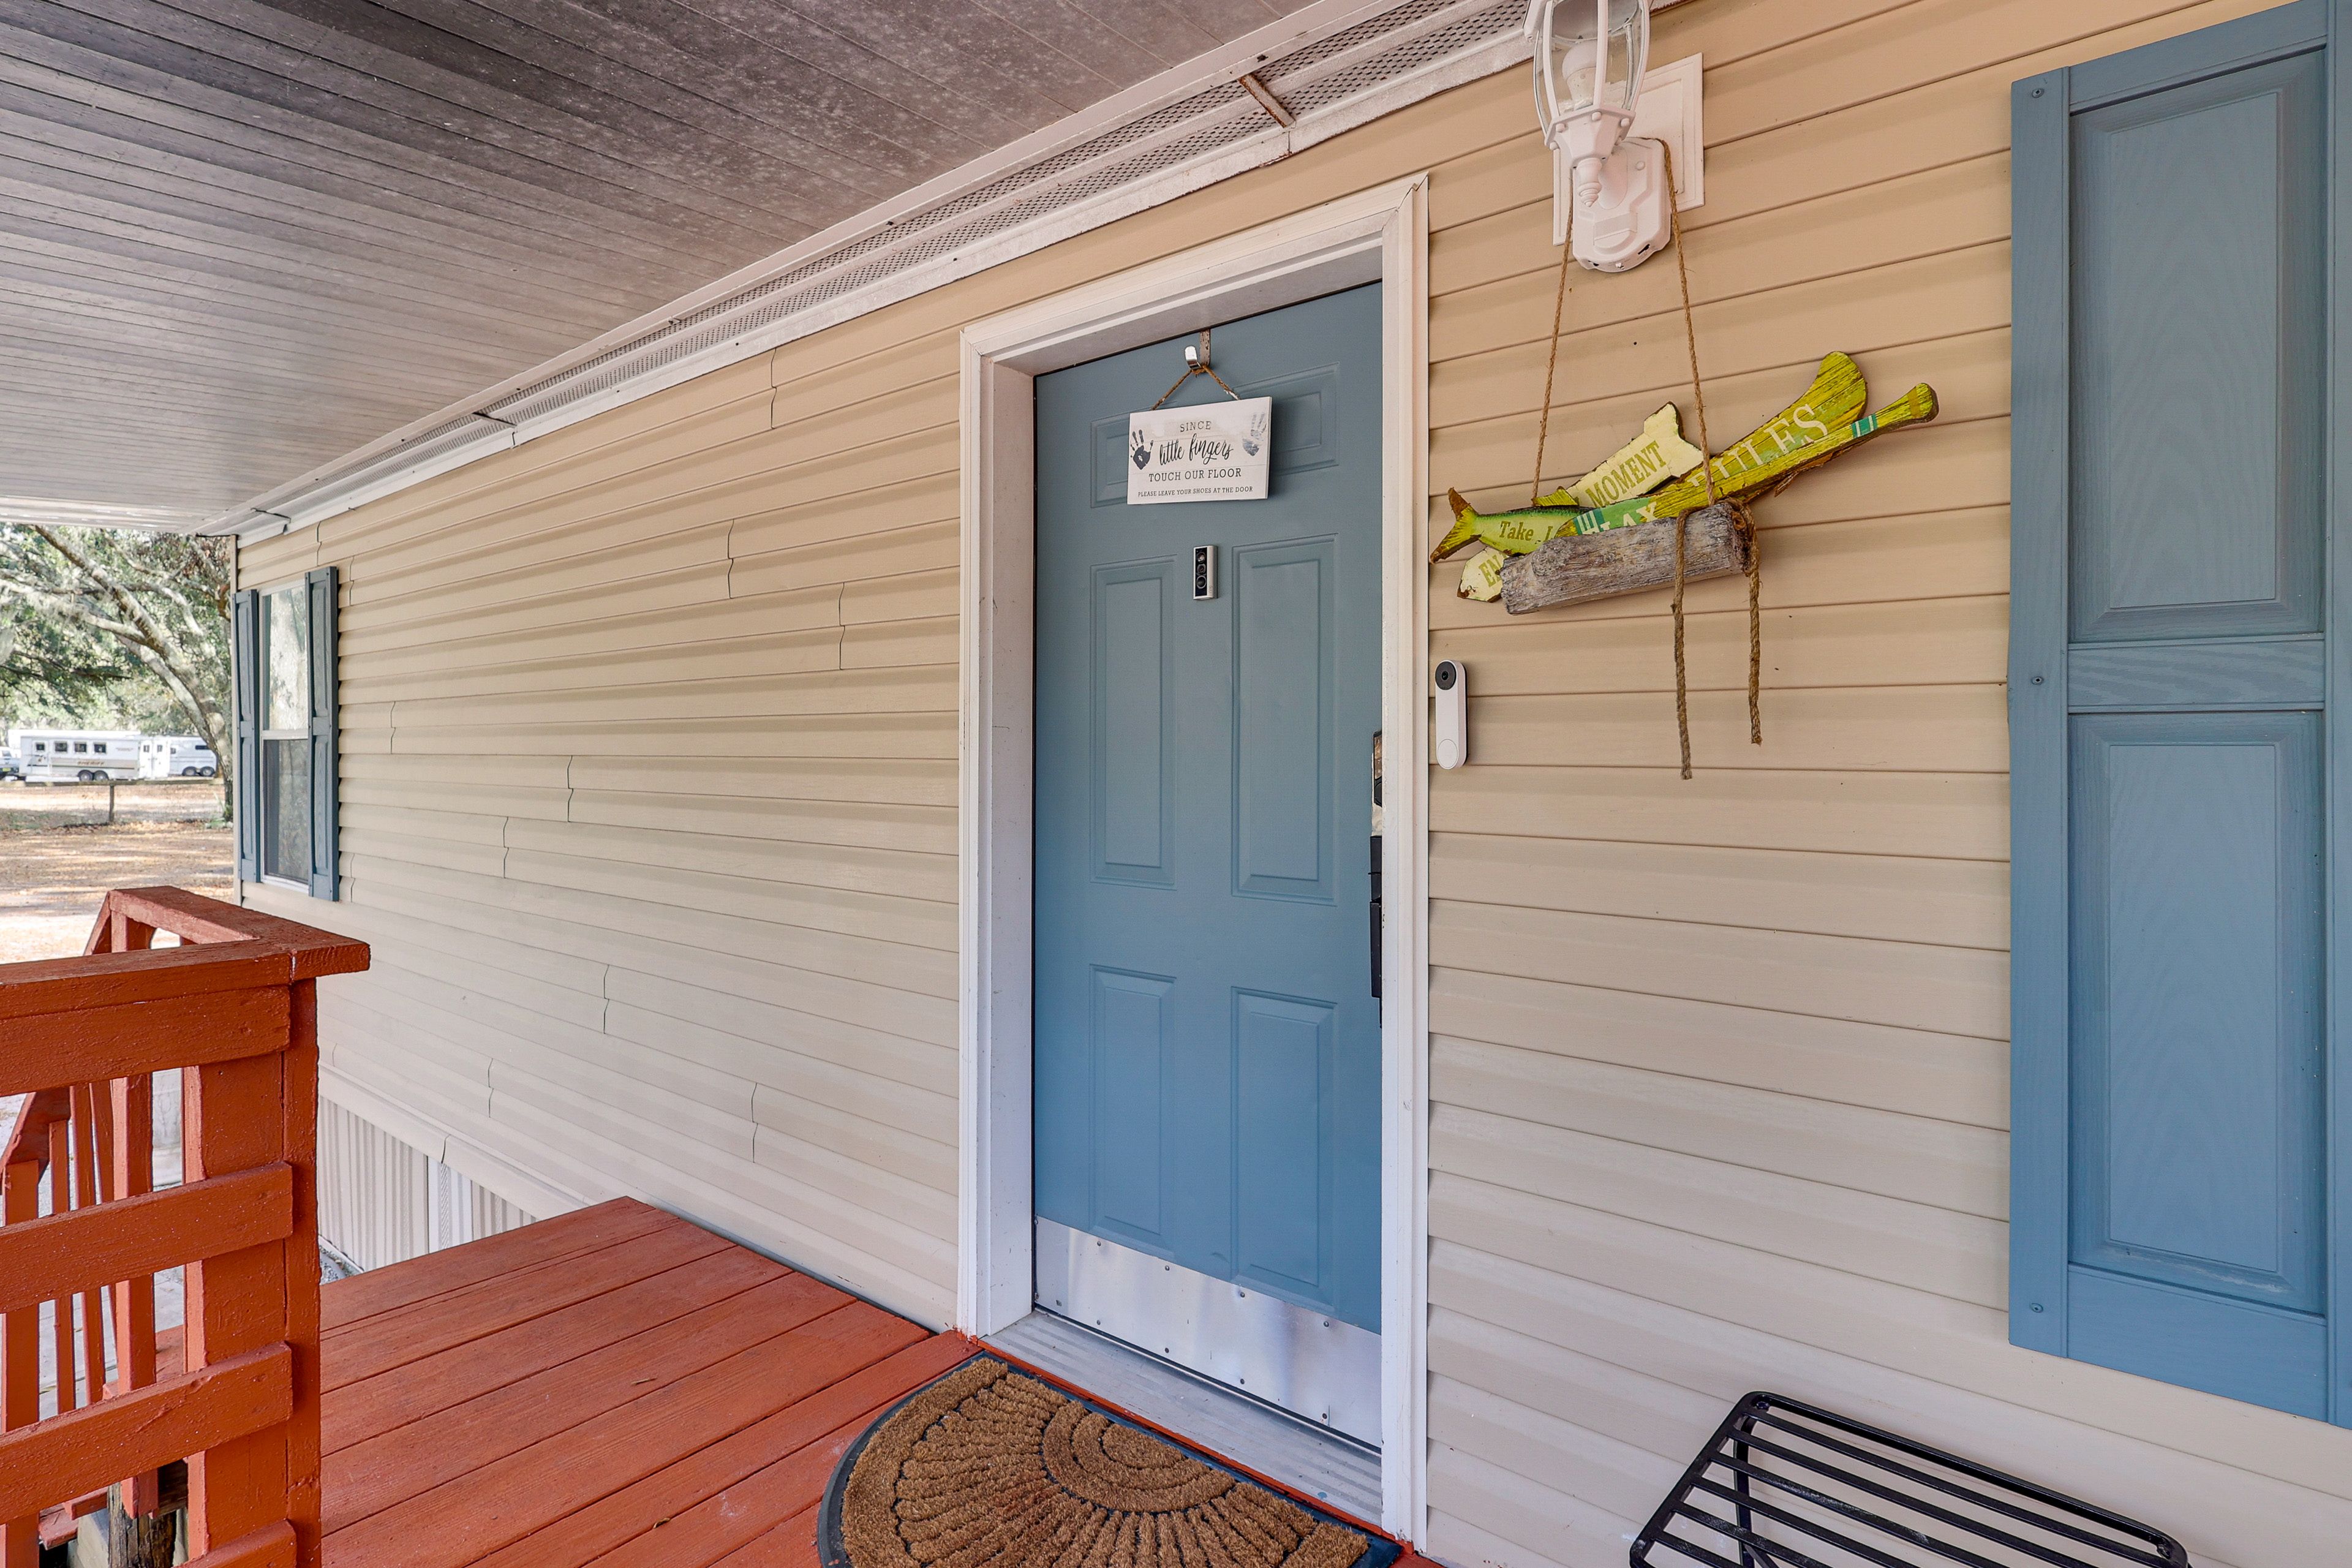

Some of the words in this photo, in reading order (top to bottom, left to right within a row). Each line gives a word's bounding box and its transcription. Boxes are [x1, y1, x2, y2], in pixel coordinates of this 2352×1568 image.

[1180, 421, 1212, 432] SINCE
[1159, 439, 1185, 466] little
[1189, 433, 1234, 465] fingers
[1148, 472, 1181, 482] TOUCH
[1185, 470, 1204, 480] OUR
[1208, 467, 1242, 478] FLOOR
[1585, 440, 1666, 507] MOMENT
[1499, 521, 1534, 541] Take
